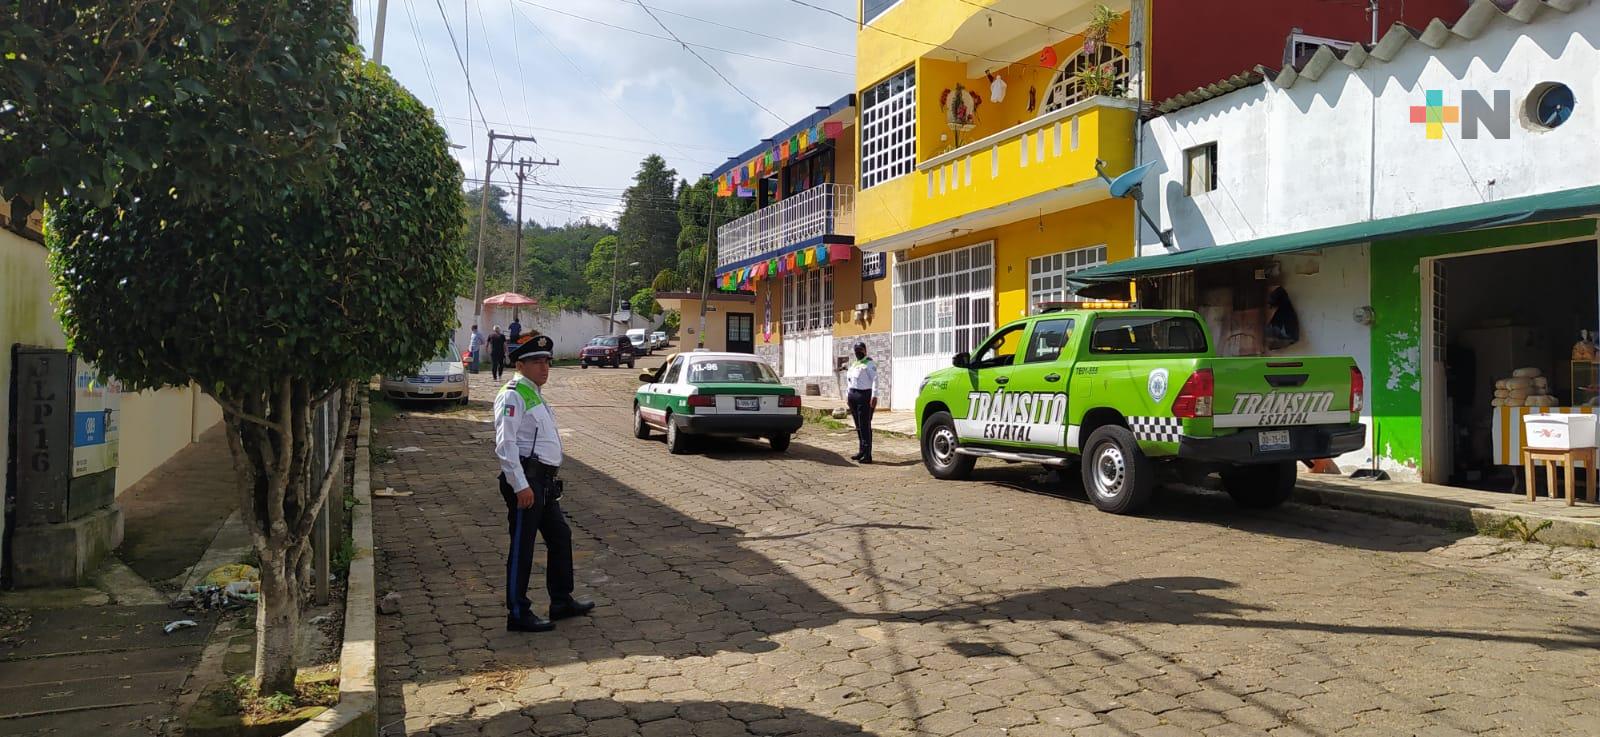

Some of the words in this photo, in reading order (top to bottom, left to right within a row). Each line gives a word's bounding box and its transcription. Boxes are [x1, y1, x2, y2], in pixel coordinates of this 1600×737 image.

[692, 363, 718, 371] XL-96
[966, 386, 1069, 424] TRÁNSITO
[1232, 389, 1334, 414] TRÁNSITO
[1258, 413, 1308, 425] ESTATAL
[983, 424, 1032, 442] ESTATAL
